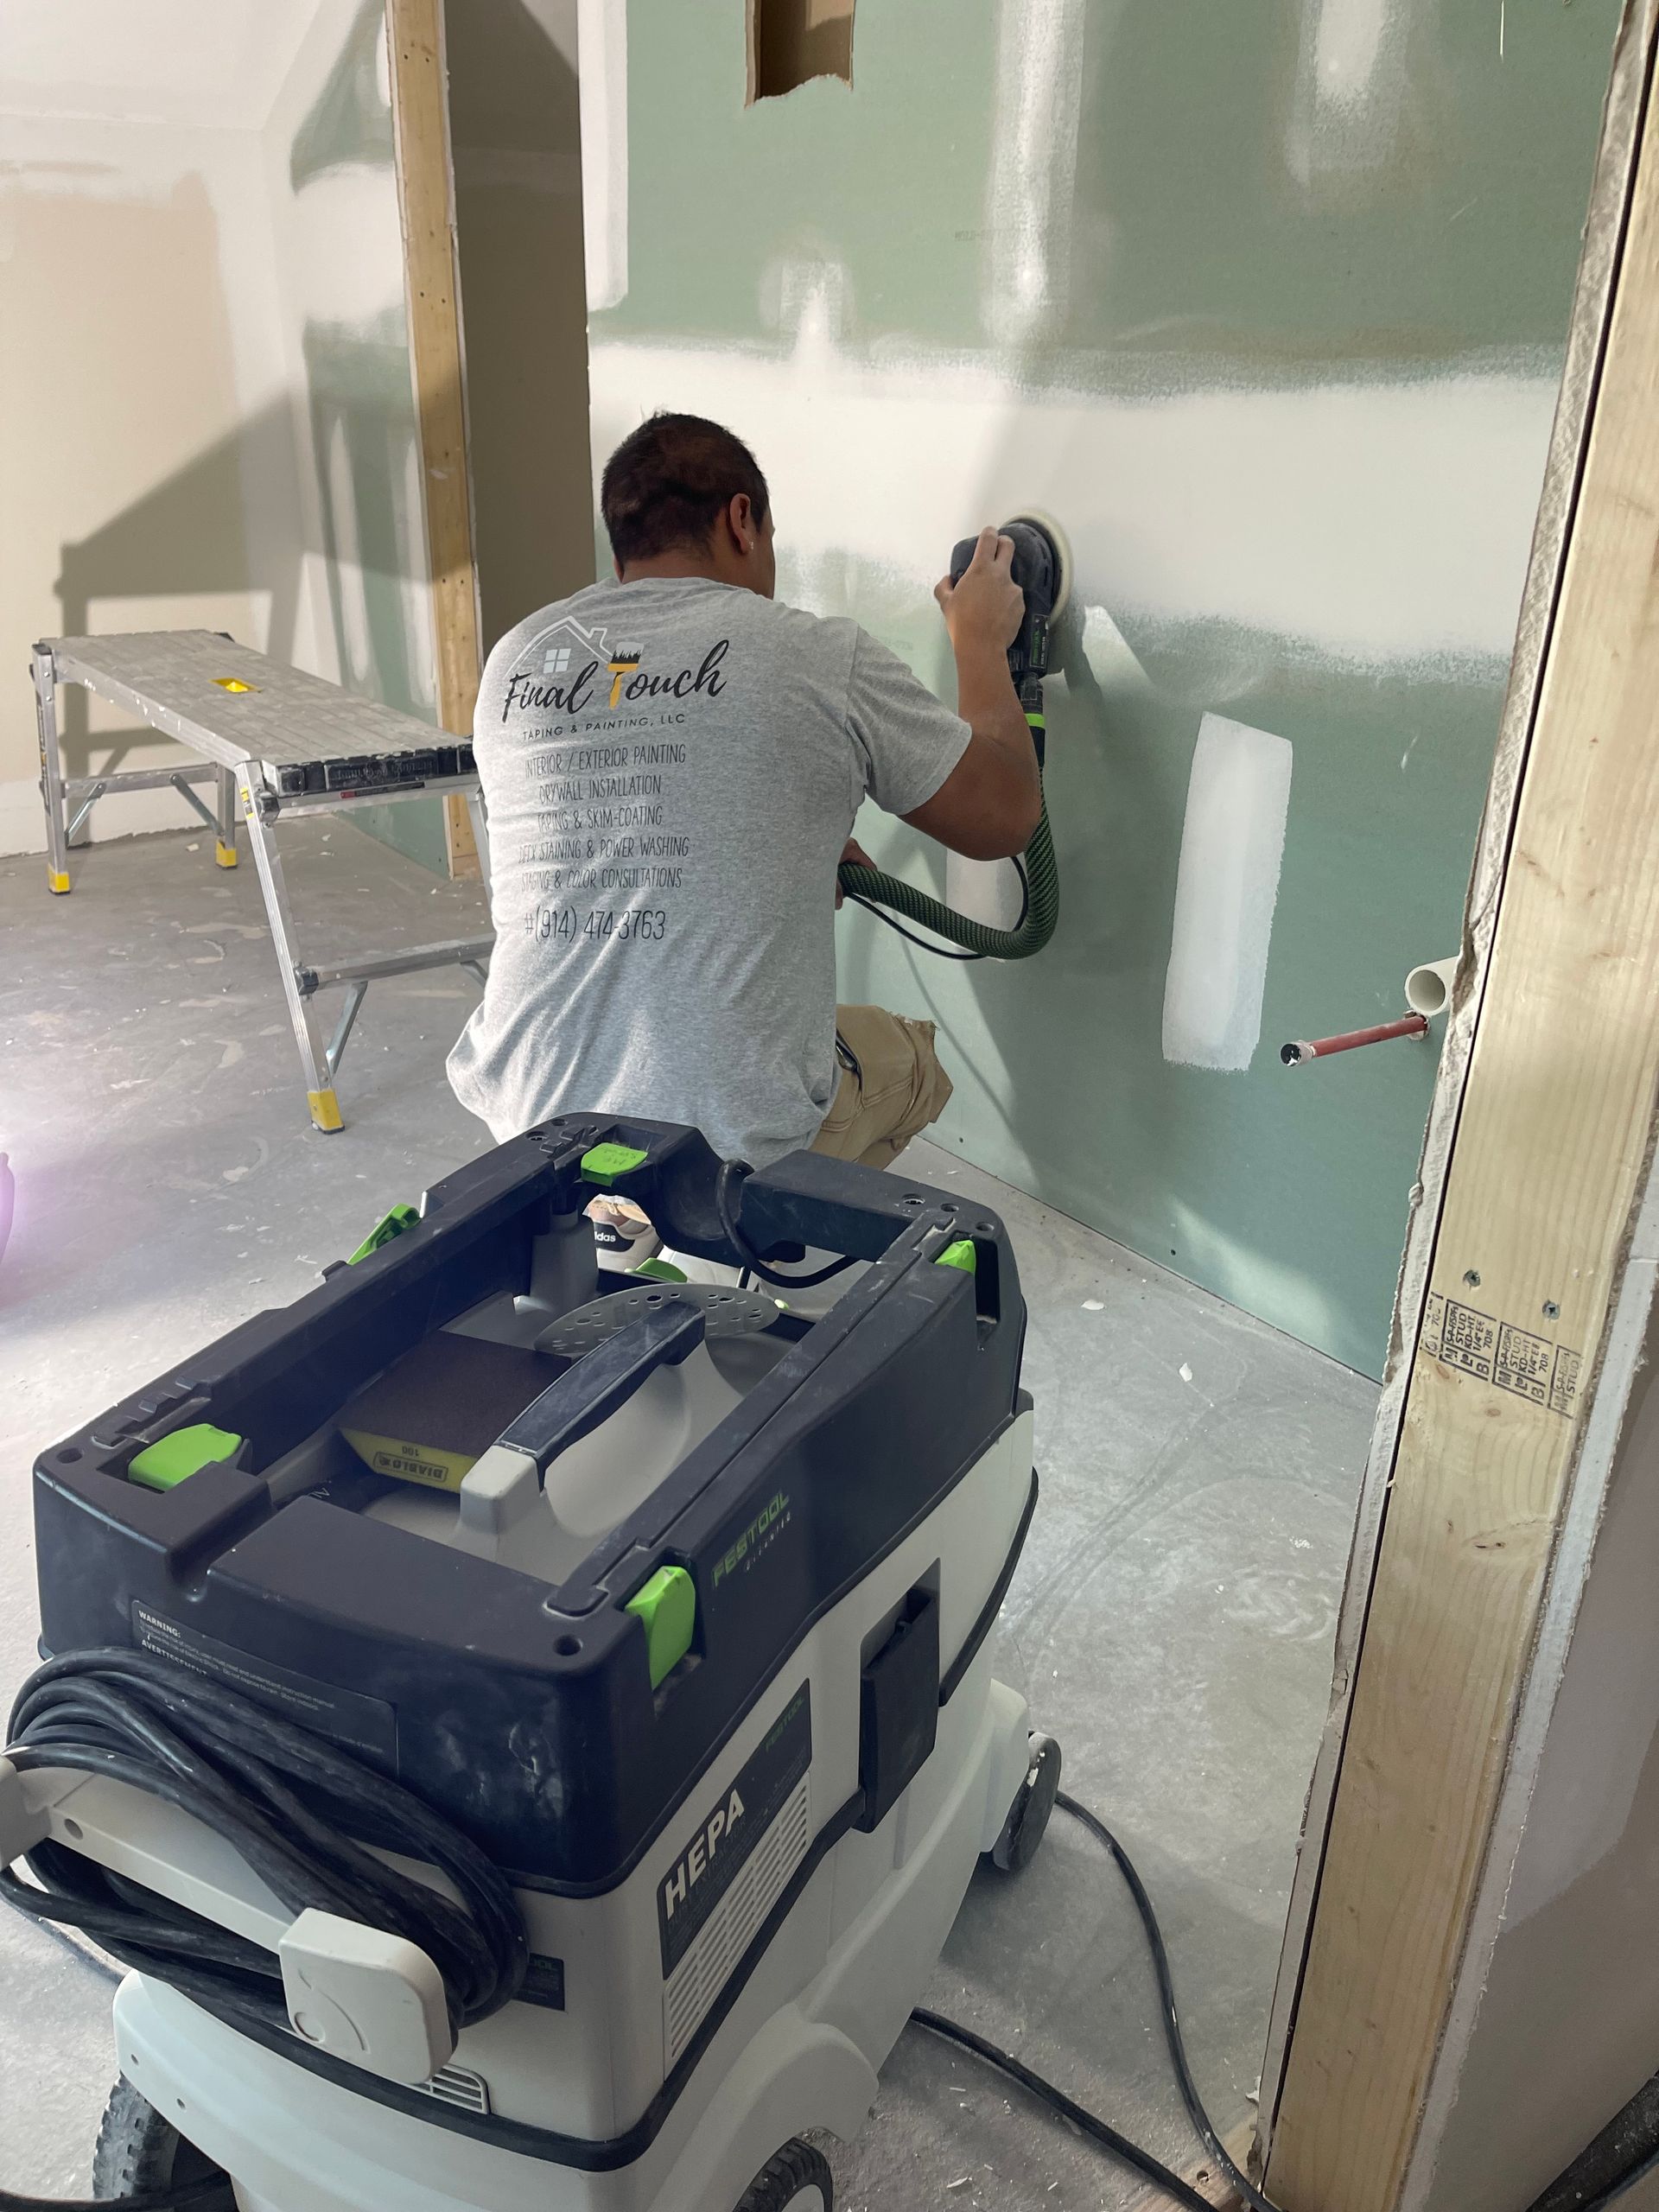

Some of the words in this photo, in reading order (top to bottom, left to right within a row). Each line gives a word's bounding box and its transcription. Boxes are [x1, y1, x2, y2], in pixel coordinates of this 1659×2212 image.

[502, 660, 599, 723] Final
[607, 639, 729, 710] Touch
[523, 726, 563, 741] TAPING
[570, 724, 578, 734] &
[586, 717, 654, 731] PAINTING,
[661, 714, 685, 725] LLC
[525, 753, 563, 778] INTERIOR
[567, 752, 575, 772] /
[579, 747, 629, 771] EXTERIOR
[633, 744, 686, 766] PAINTING
[539, 781, 584, 805] DRYWALL
[589, 774, 662, 799] INSTALLATION
[537, 810, 569, 832] TAPING
[574, 810, 583, 830] &
[587, 805, 664, 830] SKIM-COATING
[539, 839, 582, 861] STAINING
[587, 839, 594, 859] &
[600, 837, 634, 858] POWER
[640, 836, 690, 858] WASHING
[554, 869, 563, 889] &
[567, 868, 597, 889] COLOR
[601, 868, 683, 889] CONSULTATIONS
[524, 906, 577, 944] #(914)
[584, 910, 666, 940] 474-3763
[1456, 1313, 1466, 1344] STUD
[1483, 1330, 1493, 1349] 708
[1510, 1336, 1522, 1368] STUD
[1518, 1338, 1530, 1373] KD-HT
[1539, 1353, 1549, 1373] 708
[1476, 1362, 1490, 1375] B
[1498, 1370, 1512, 1385] M
[1566, 1359, 1580, 1394] STUD
[1531, 1387, 1545, 1400] B
[403, 1446, 419, 1457] 100
[393, 1459, 443, 1479] DIABLO
[711, 1491, 790, 1588] FESTOOL
[139, 1610, 181, 1638] WARNING:
[664, 1788, 746, 1921] HEPA
